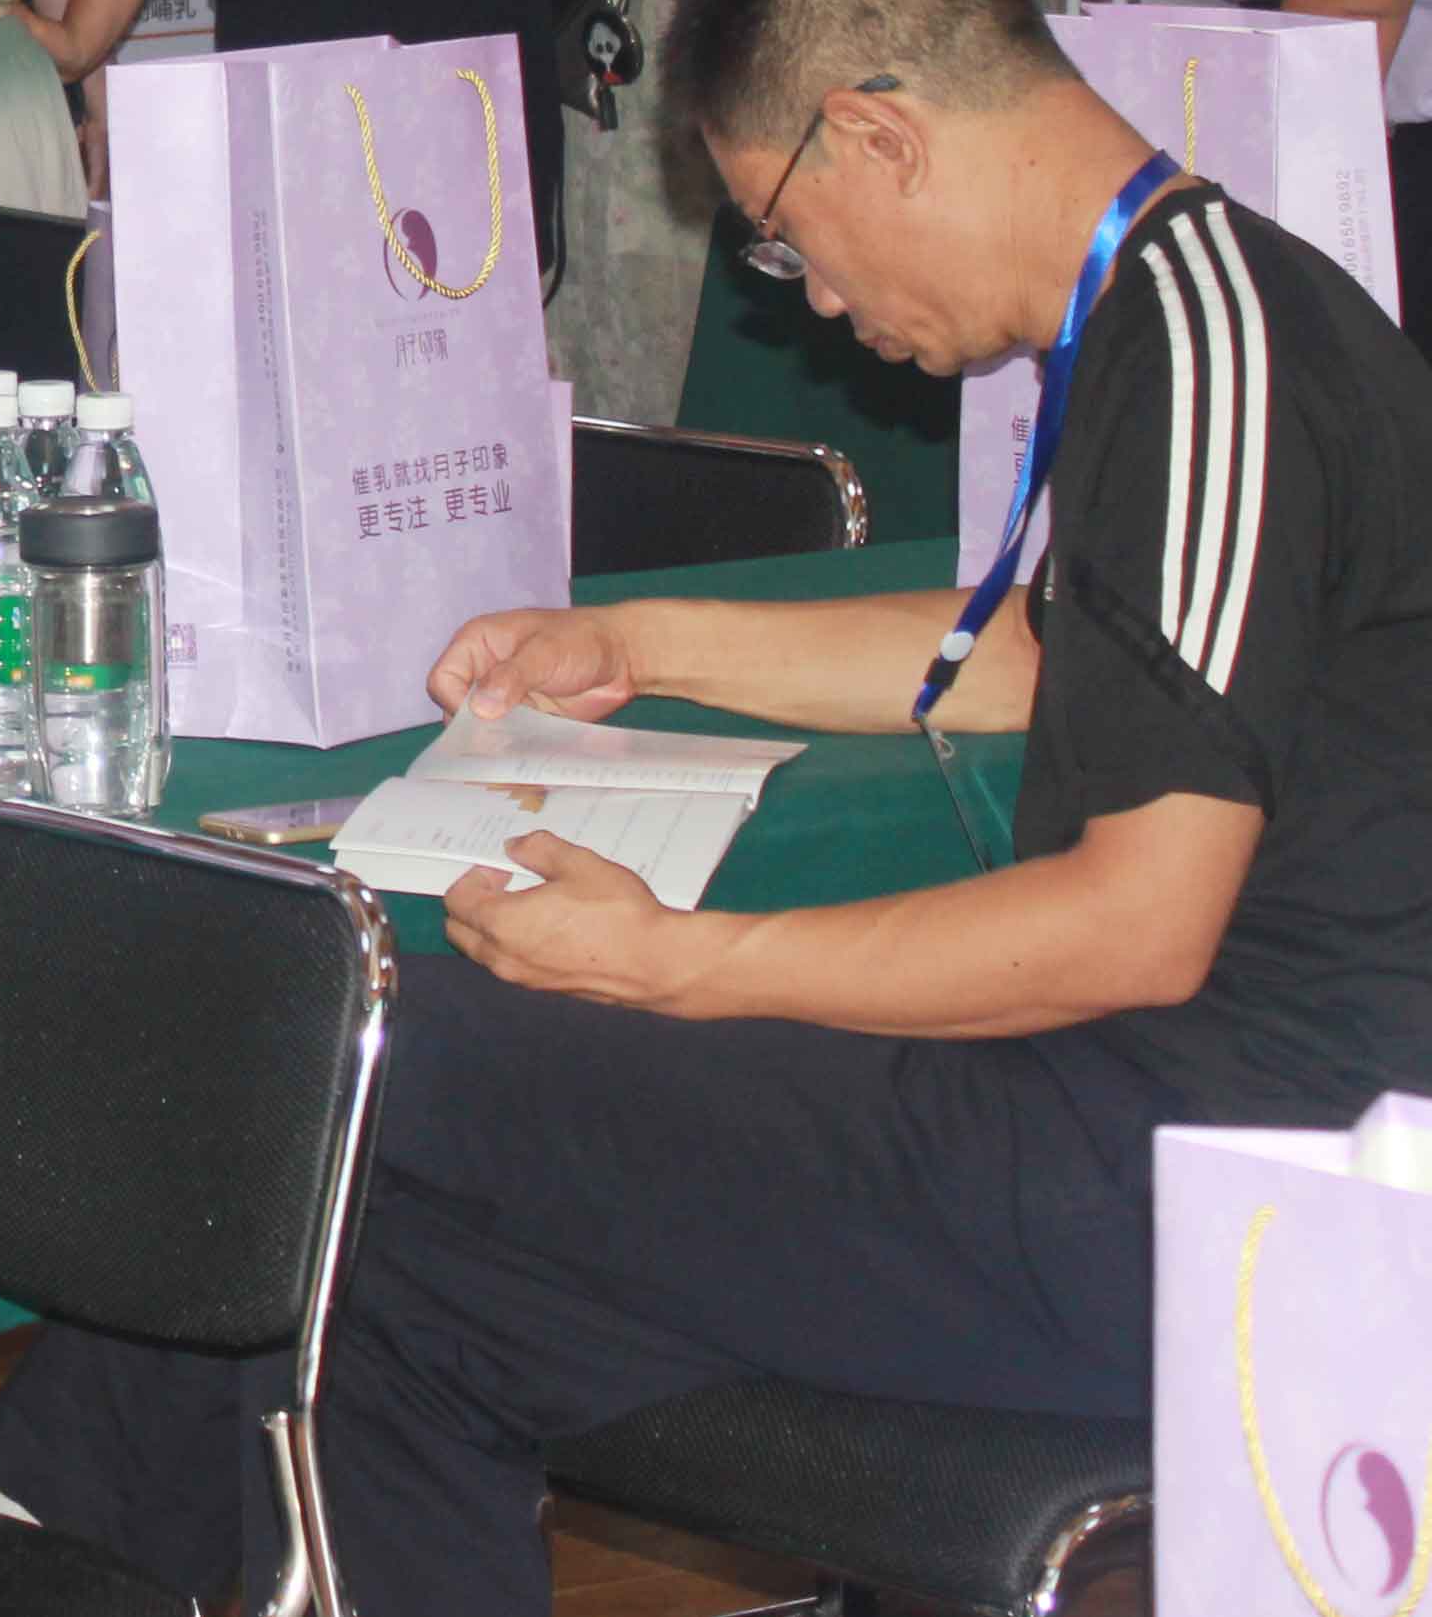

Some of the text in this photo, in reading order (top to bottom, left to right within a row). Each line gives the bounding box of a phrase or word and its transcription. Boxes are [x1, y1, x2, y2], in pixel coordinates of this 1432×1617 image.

[352, 442, 510, 495] 催乳就找月子印象
[357, 478, 513, 541] 更专注 更专业
